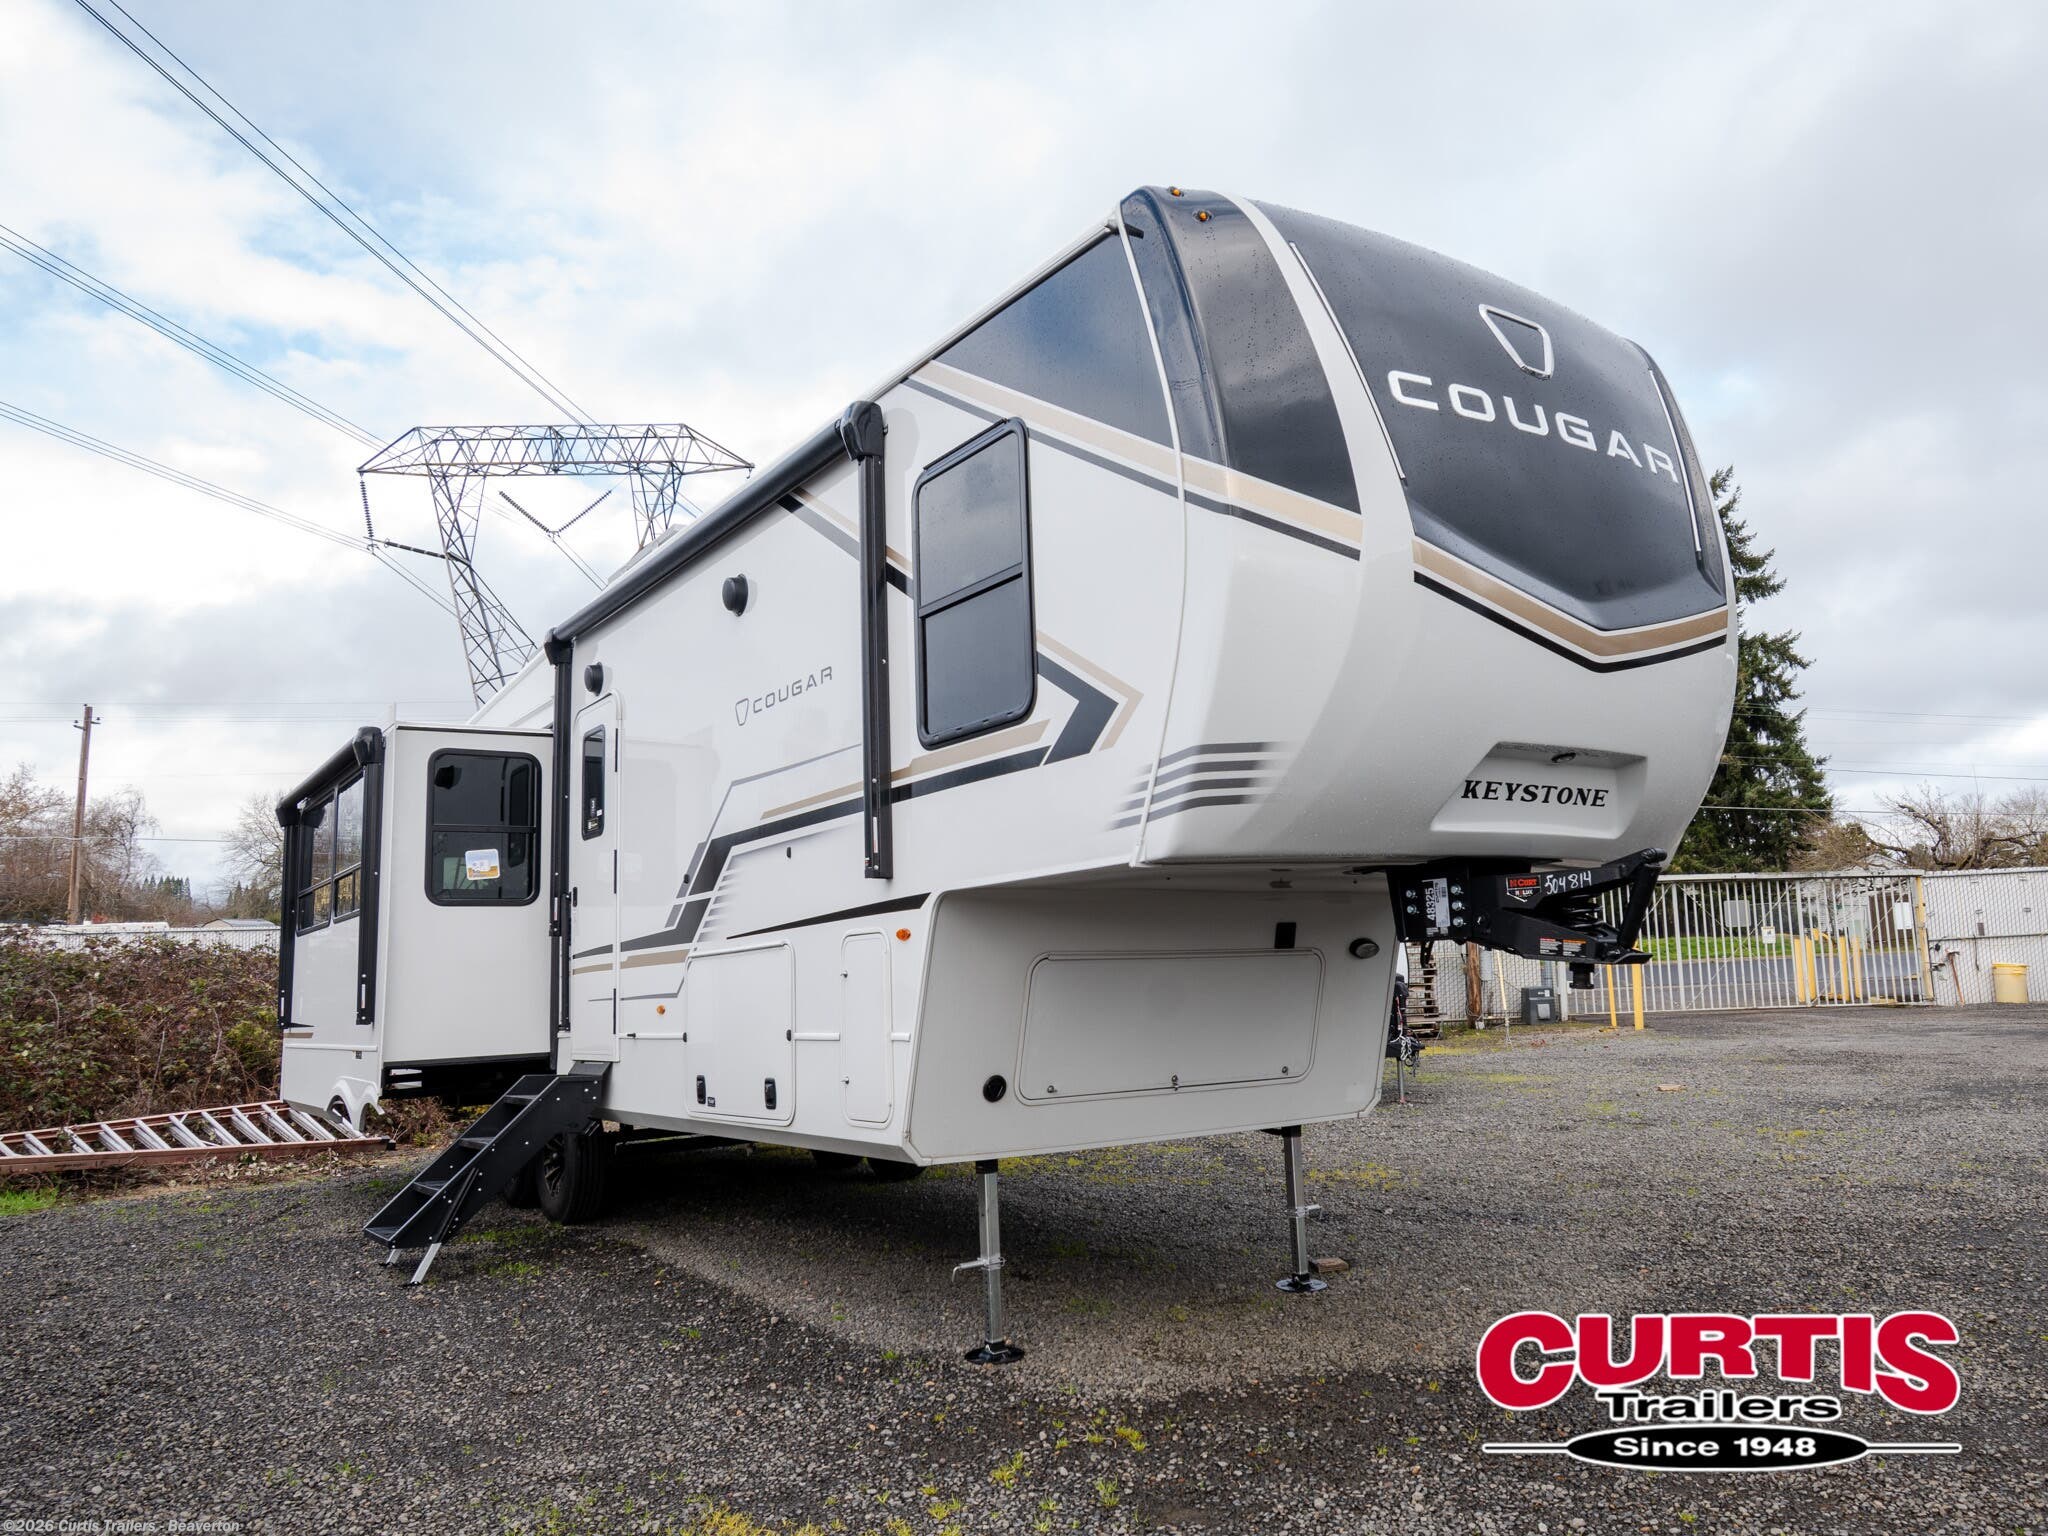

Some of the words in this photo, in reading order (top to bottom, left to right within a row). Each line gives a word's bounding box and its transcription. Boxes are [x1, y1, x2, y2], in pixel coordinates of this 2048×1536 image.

[1387, 370, 1679, 483] COUGAR
[753, 666, 832, 713] COUGAR
[1461, 779, 1609, 807] KEYSTONE
[1544, 870, 1592, 895] 504814
[1425, 887, 1436, 921] 48325
